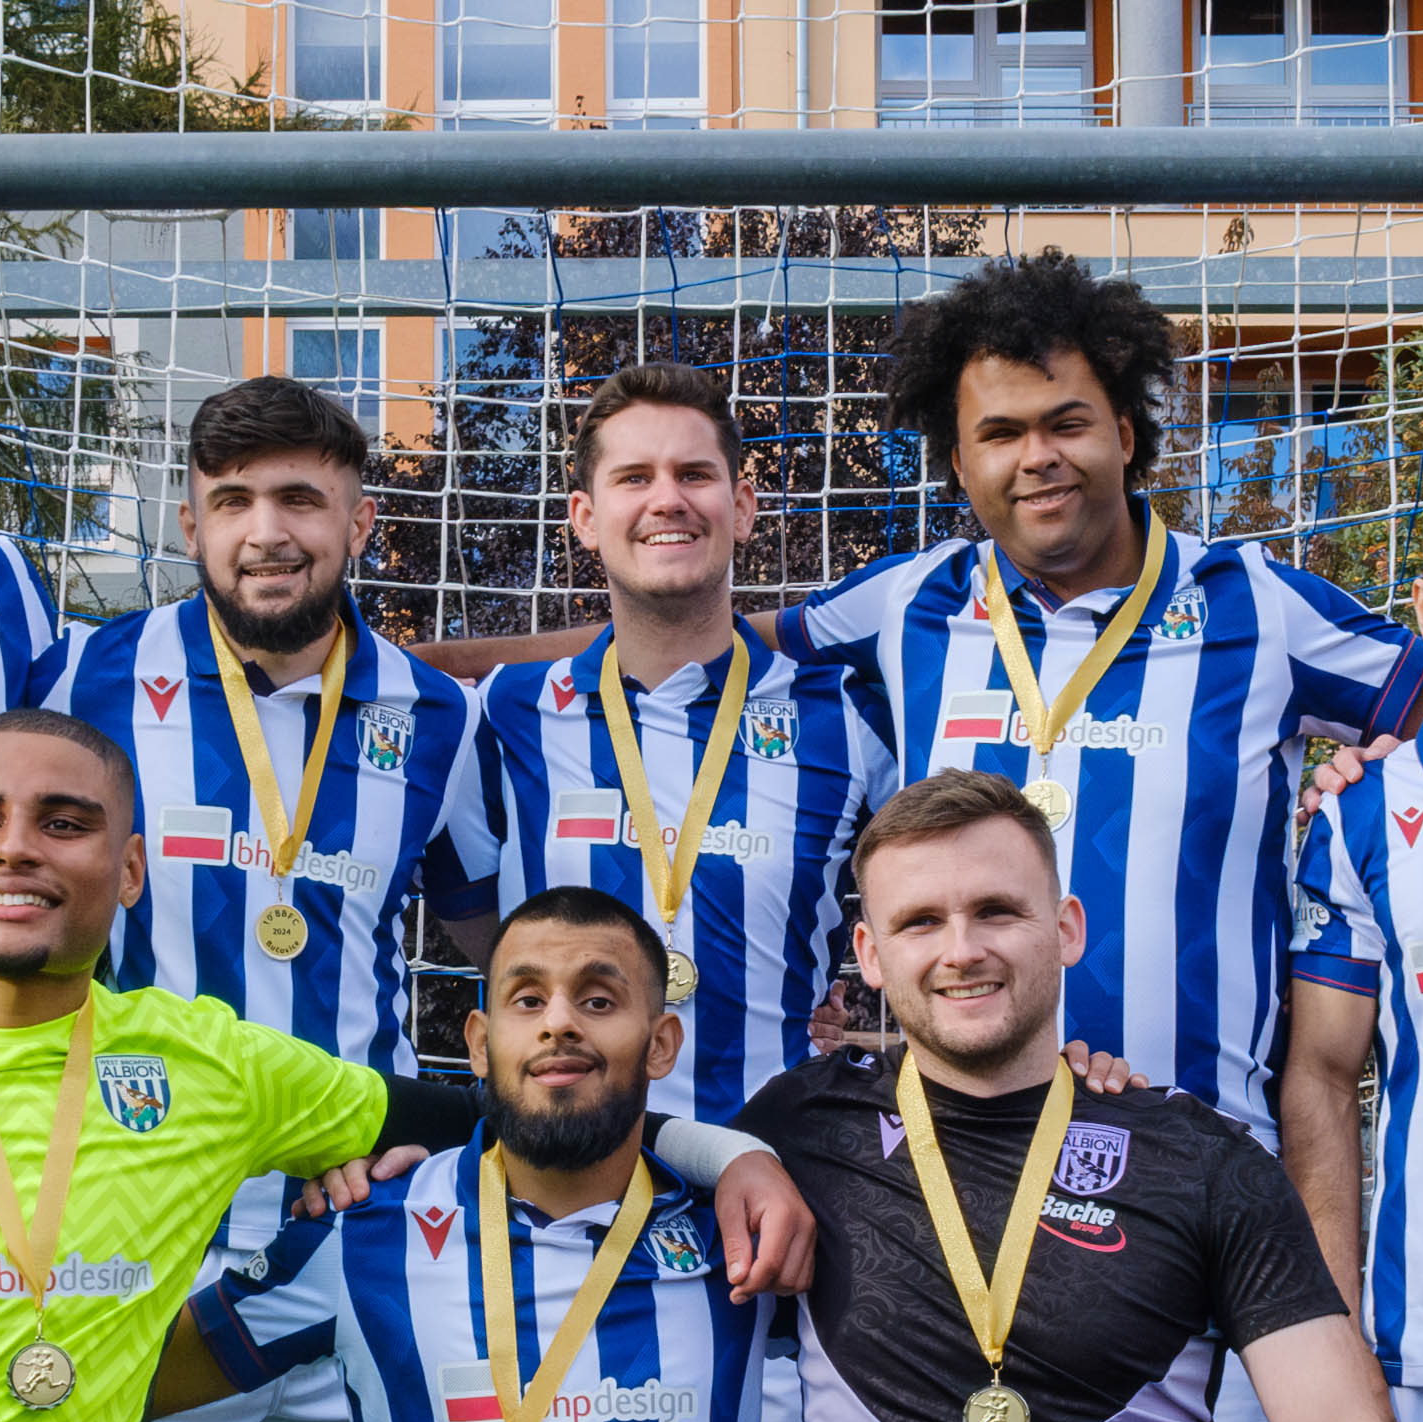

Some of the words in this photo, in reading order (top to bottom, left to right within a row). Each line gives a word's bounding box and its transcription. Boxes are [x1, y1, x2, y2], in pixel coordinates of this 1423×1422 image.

[361, 708, 411, 733] ALBION
[102, 1065, 163, 1078] ALBION
[1064, 1136, 1120, 1153] ALBION
[1040, 1194, 1116, 1227] Bache
